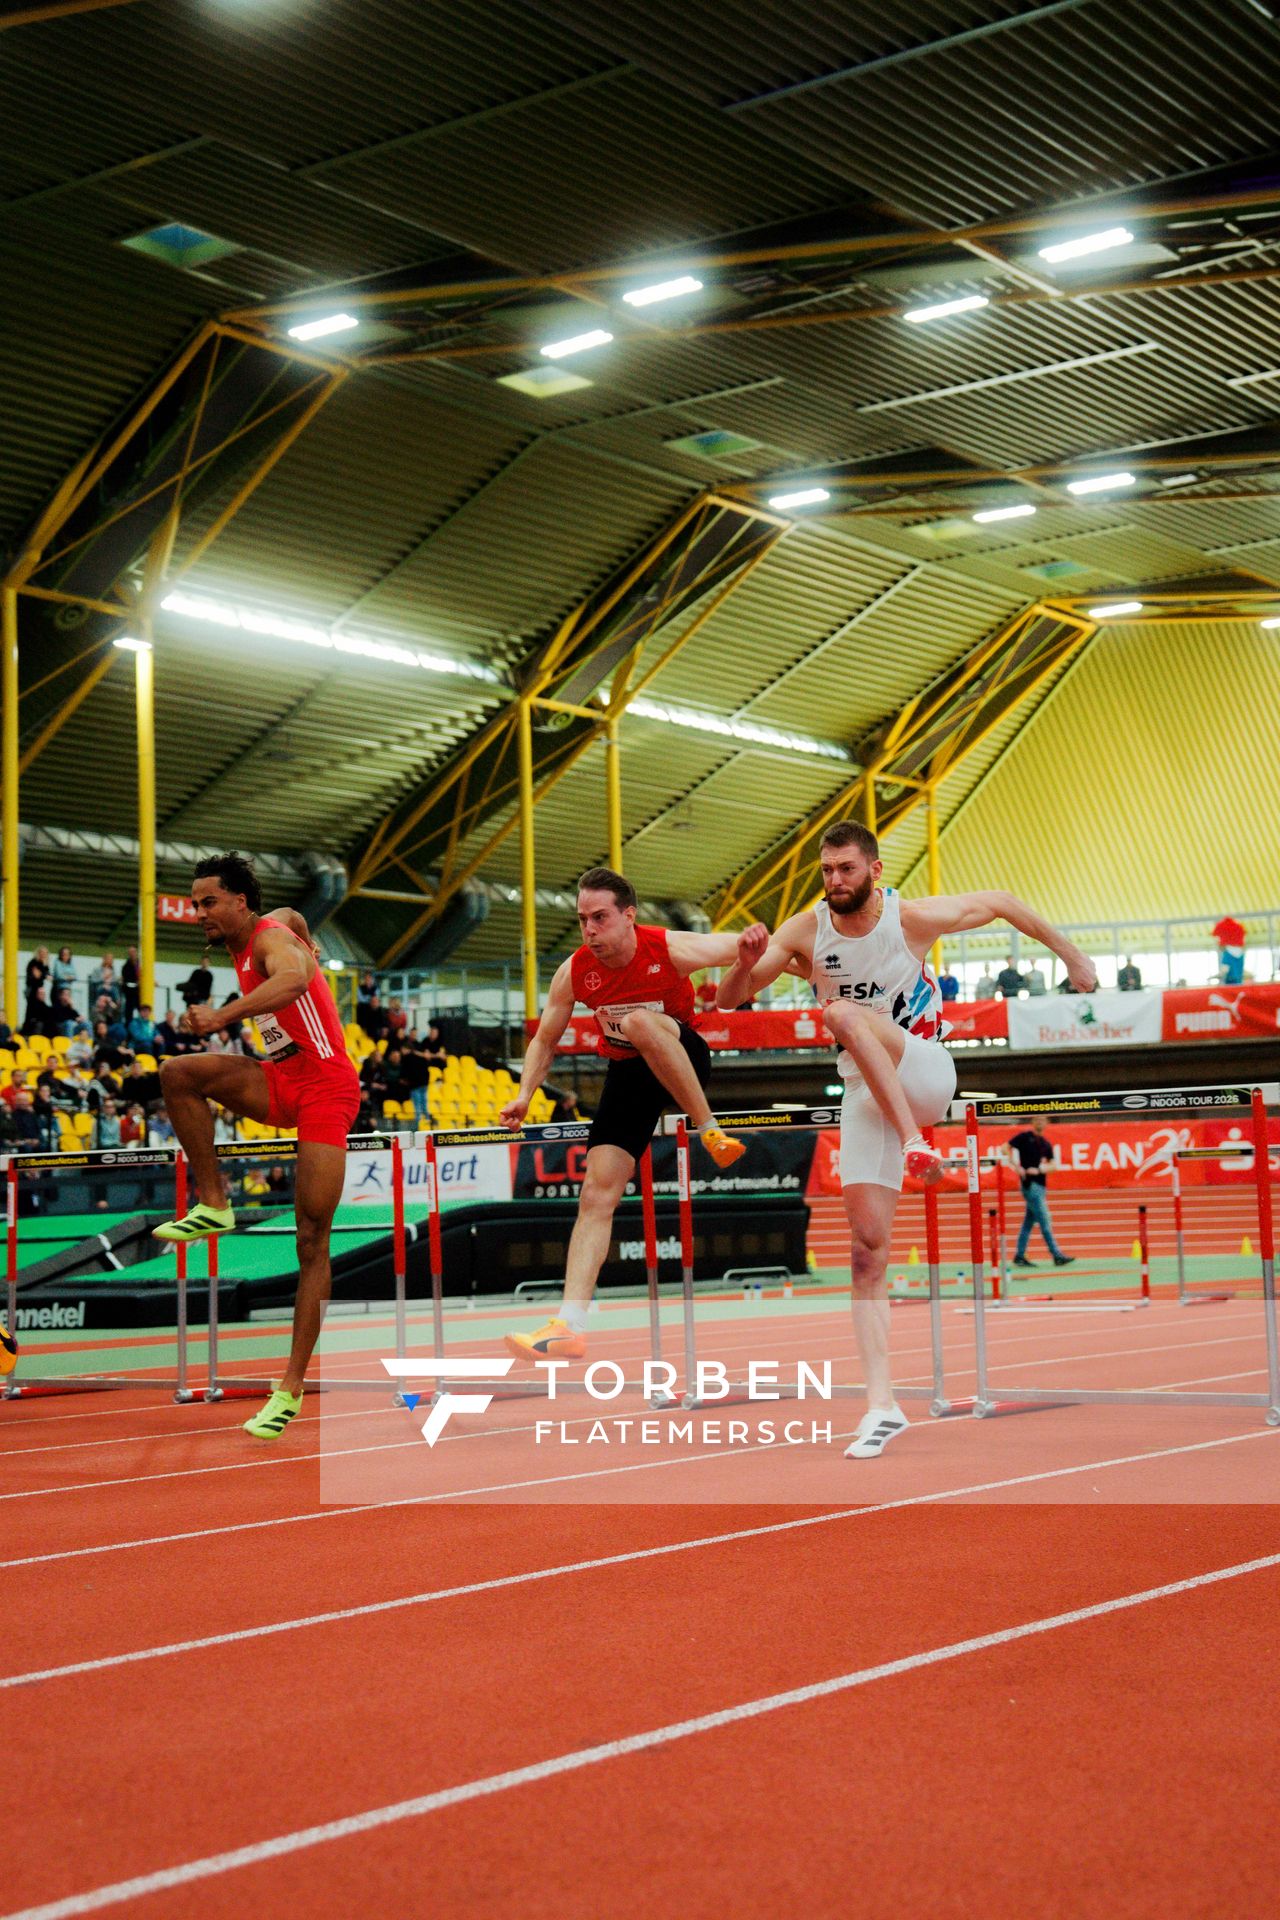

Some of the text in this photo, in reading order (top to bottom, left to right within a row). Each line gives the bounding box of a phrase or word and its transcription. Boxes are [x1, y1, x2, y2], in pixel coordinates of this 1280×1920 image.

[1150, 1097, 1186, 1107] INDOOR
[1188, 1096, 1212, 1106] TOUR
[1214, 1094, 1239, 1104] 2026
[692, 1113, 792, 1127] usinessNetzwerk
[652, 1174, 800, 1195] wwwgo-dortmund.de
